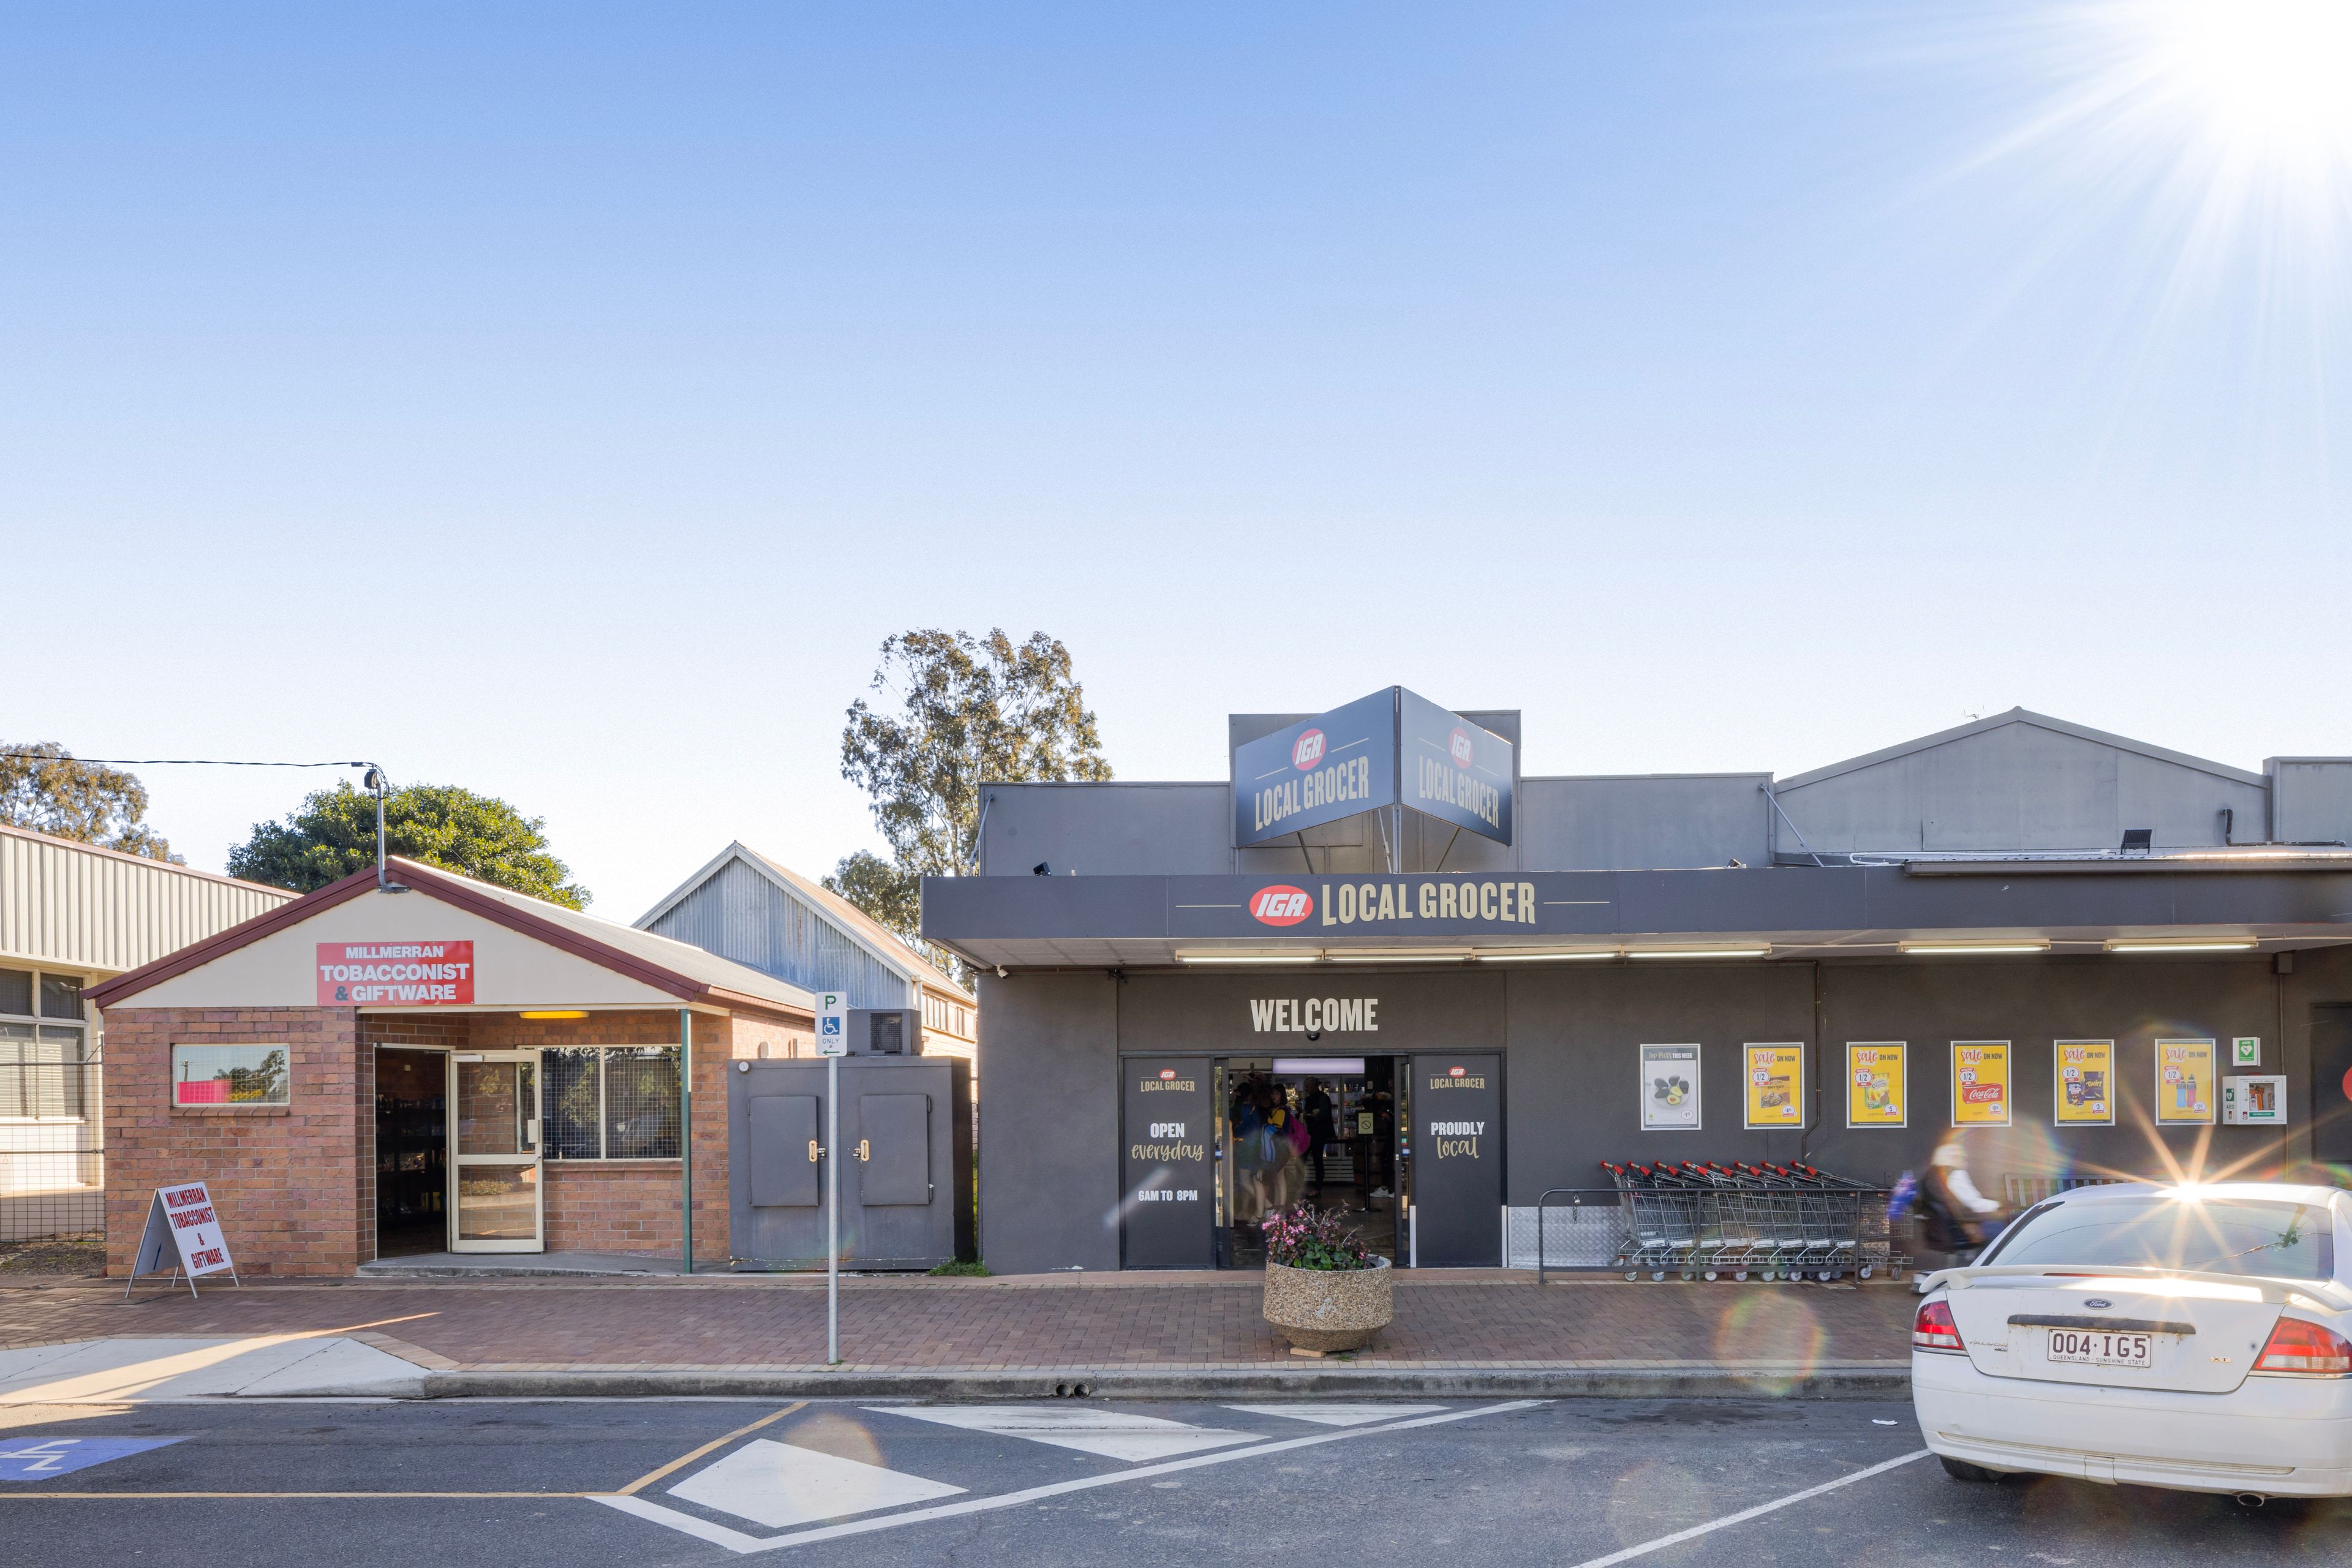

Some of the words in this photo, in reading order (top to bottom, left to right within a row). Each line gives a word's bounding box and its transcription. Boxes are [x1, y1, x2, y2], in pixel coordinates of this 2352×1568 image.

[1295, 733, 1324, 765] IGA
[1451, 733, 1471, 762] IGA
[1256, 779, 1301, 832] LOCAL
[1303, 756, 1369, 810] GROCER
[1419, 755, 1455, 804] LOCAL
[1457, 772, 1499, 829] GROCER
[1256, 893, 1307, 917] IGA
[1322, 883, 1412, 926] LOCAL
[1419, 882, 1536, 924] GROCER
[345, 945, 443, 959] MILLMERRAN
[320, 963, 470, 982] TOBACCONIST
[335, 986, 349, 1001] &
[352, 984, 456, 1001] GIFTWARE
[825, 995, 836, 1010] P
[1250, 998, 1378, 1032] WELCOME
[1754, 1052, 1774, 1064] sale
[1856, 1050, 1877, 1063] sale
[1961, 1049, 1981, 1062] sale
[2064, 1048, 2084, 1061] sale
[1140, 1081, 1164, 1092] LOCAL
[1166, 1080, 1195, 1092] GROCER
[1430, 1078, 1453, 1090] LOCAL
[1455, 1078, 1485, 1089] GROCER
[1150, 1123, 1185, 1138] OPEN
[1431, 1122, 1485, 1136] PROUDLY
[1131, 1140, 1204, 1161] everyday
[1437, 1136, 1479, 1159] local
[165, 1187, 207, 1208] MILLMERRAN
[1138, 1190, 1159, 1201] 6AM
[1161, 1190, 1173, 1201] TO
[1177, 1190, 1197, 1201] 8PM
[170, 1207, 215, 1229] TOBACCONIST
[197, 1233, 205, 1246] &
[190, 1247, 224, 1269] GIFTWARE
[2089, 1300, 2106, 1308] Ford
